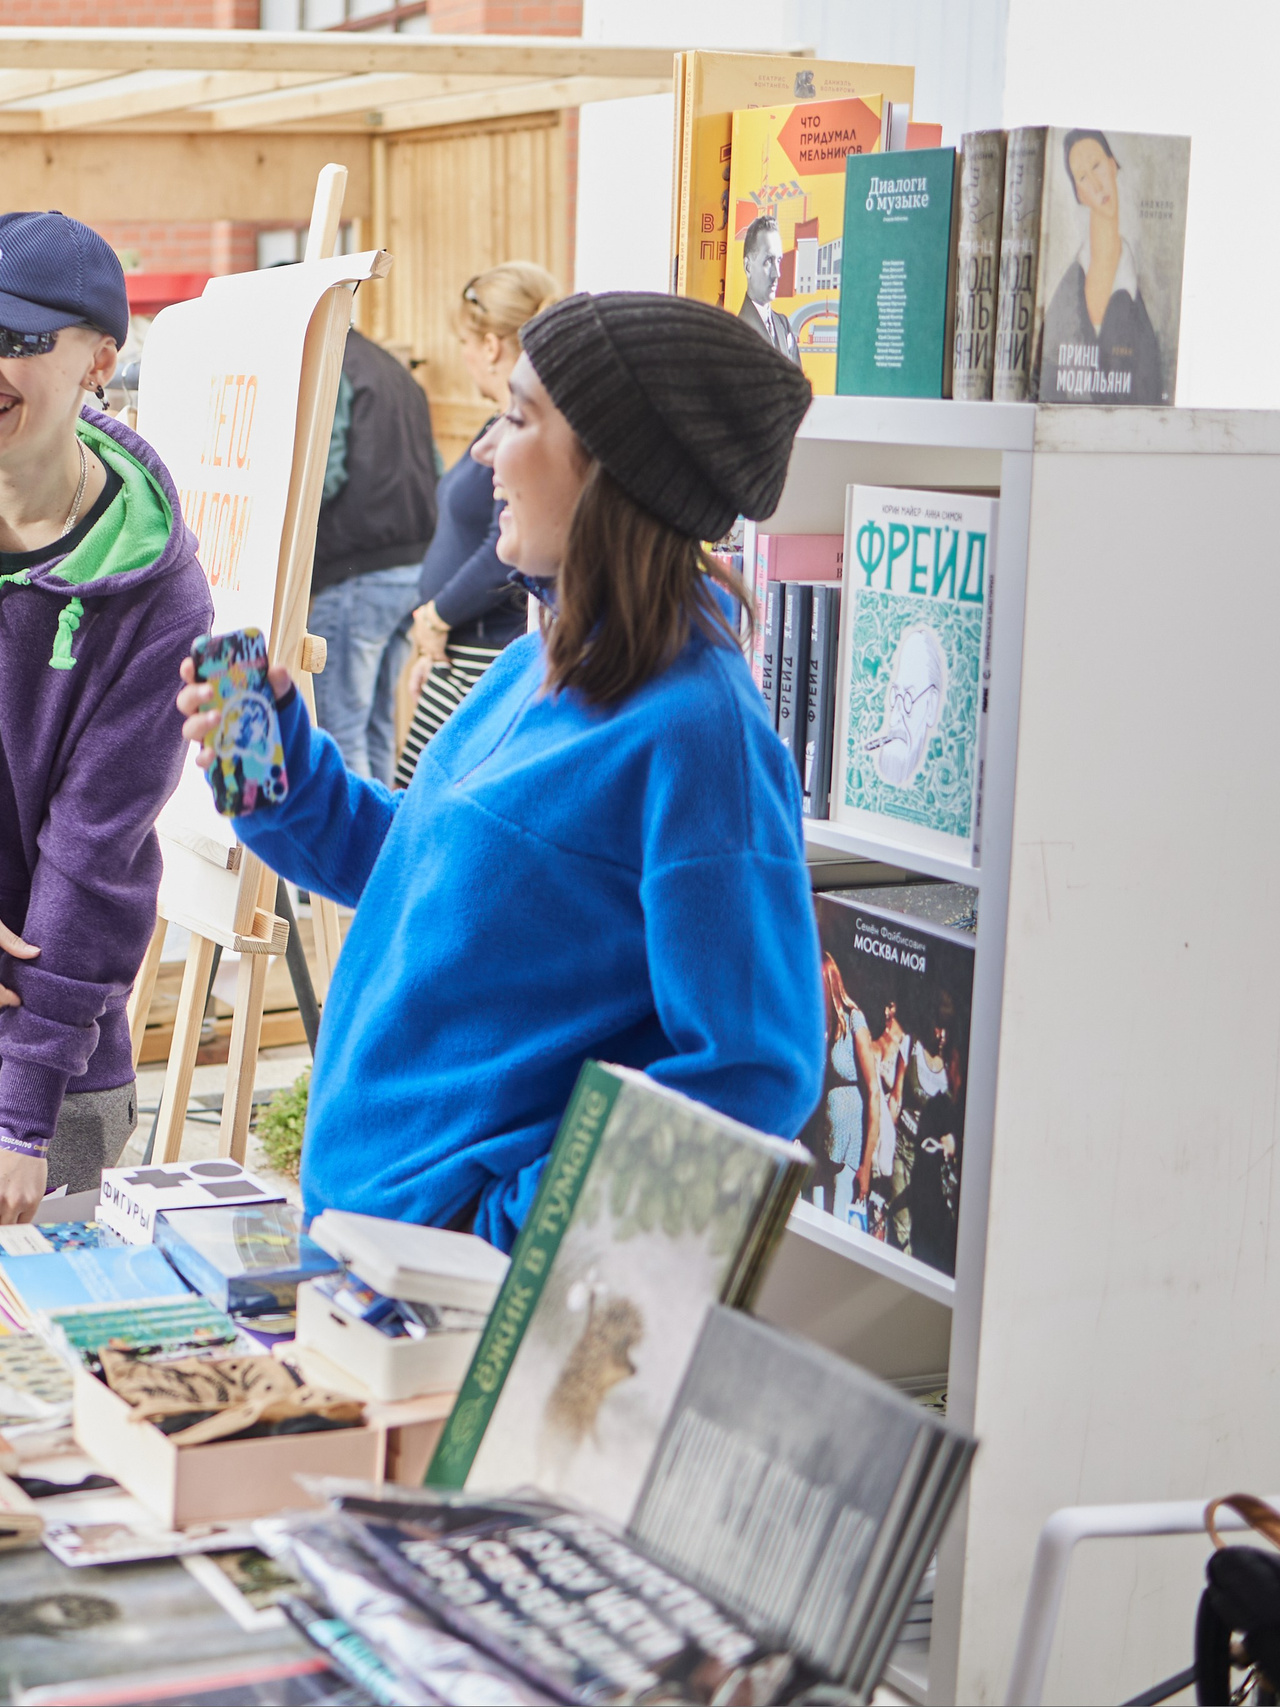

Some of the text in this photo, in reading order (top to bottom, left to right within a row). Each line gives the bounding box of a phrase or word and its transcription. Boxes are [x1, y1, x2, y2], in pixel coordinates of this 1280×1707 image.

[800, 116, 820, 128] ЧТО
[800, 129, 856, 145] ПРИДУМАЛ
[799, 145, 862, 161] МЕЛЬНИКОВ
[868, 177, 926, 197] Диалоги
[865, 193, 929, 215] о музыке
[1058, 344, 1099, 370] ПРИНЦ
[1056, 369, 1131, 394] МОДИЛЬЯНИ
[925, 509, 940, 518] АННА
[942, 510, 963, 522] СИМОН
[856, 520, 987, 603] ФРЕЙД
[855, 917, 926, 951] Семён Файбисович
[854, 934, 926, 972] МОСКВА МОЯ
[103, 1181, 150, 1231] ФИГУРЫ
